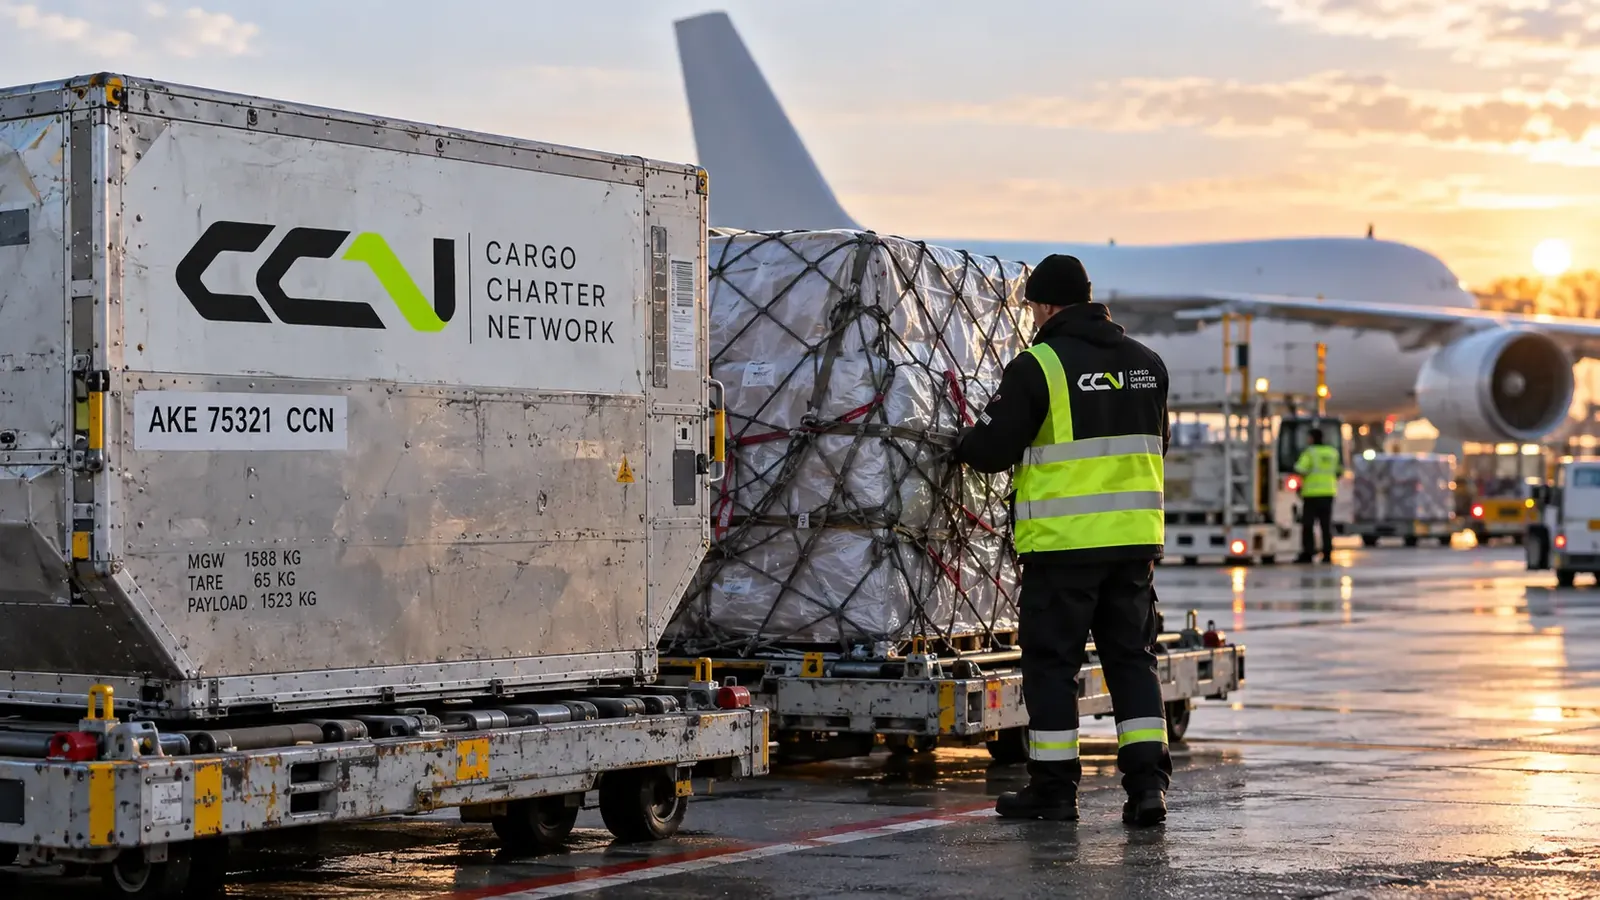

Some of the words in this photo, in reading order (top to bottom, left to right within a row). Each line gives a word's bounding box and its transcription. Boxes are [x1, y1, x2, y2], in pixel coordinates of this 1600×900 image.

[486, 240, 577, 270] CARGO
[486, 277, 606, 308] CHARTER
[488, 314, 616, 344] NETWORK
[148, 405, 198, 433] AKE
[207, 406, 272, 433] 75321
[286, 407, 334, 433] CCN
[188, 552, 225, 569] MGW
[244, 550, 277, 567] 1588
[283, 549, 301, 566] KG
[188, 574, 223, 591] TARE
[254, 572, 271, 588] 65
[278, 571, 296, 587] KG
[188, 594, 248, 613] PAYLOAD
[261, 592, 293, 609] 1523
[299, 591, 317, 607] KG
